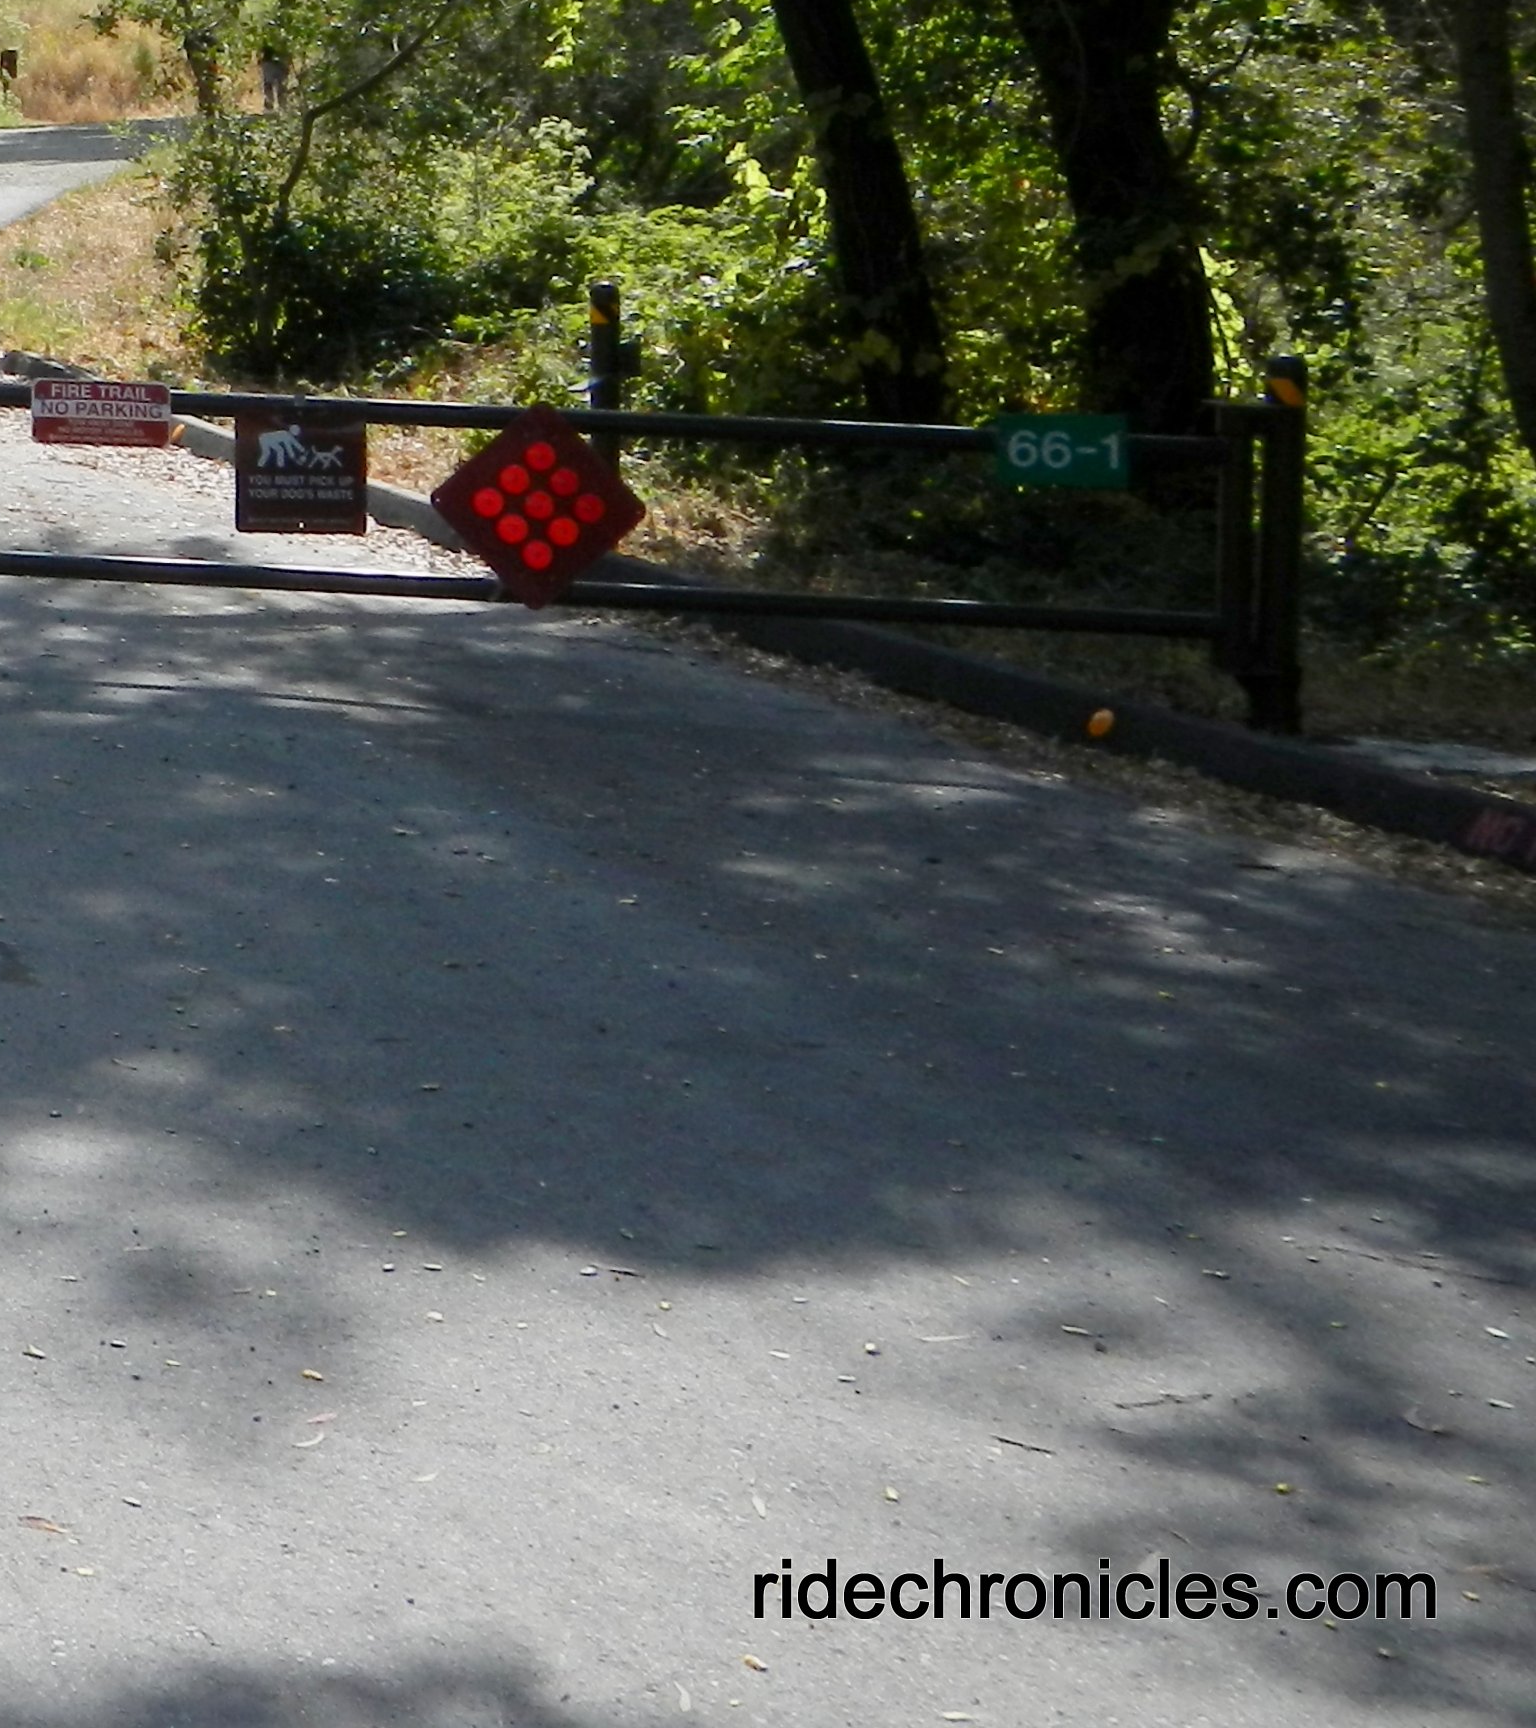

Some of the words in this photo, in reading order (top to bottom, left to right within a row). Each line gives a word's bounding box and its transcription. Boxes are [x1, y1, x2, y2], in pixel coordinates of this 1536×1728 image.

[51, 383, 92, 398] FIRE
[98, 385, 151, 401] TRAIL
[41, 401, 69, 414] NO
[76, 402, 163, 418] PARKING
[1008, 429, 1119, 470] 66-1
[249, 475, 272, 485] YOU
[249, 488, 279, 499] YOUR
[317, 489, 353, 500] WASTE
